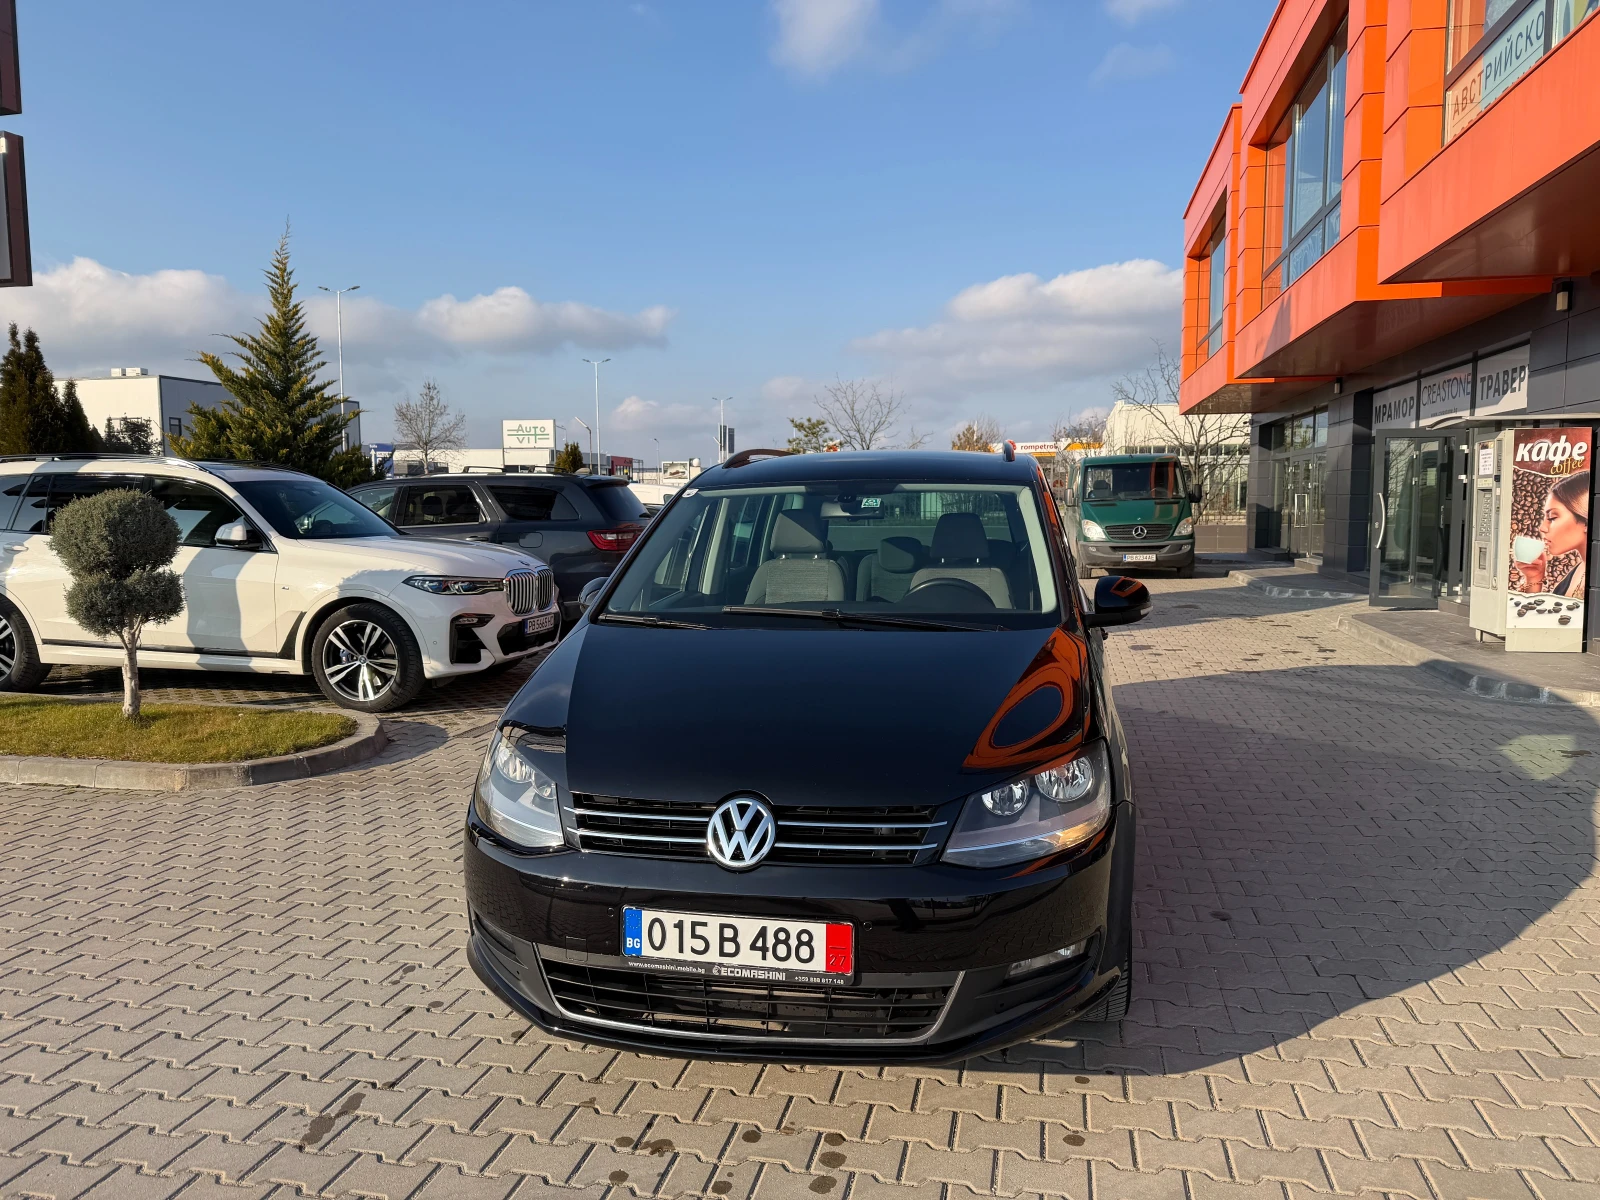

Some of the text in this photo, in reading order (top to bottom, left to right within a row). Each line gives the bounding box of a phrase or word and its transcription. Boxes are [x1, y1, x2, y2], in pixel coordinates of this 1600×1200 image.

[1452, 10, 1545, 120] АВСТРИЙСКО
[1421, 373, 1471, 407] CREASTONE
[1480, 364, 1530, 400] ТРАВЕР
[1374, 396, 1415, 424] МРАМОР
[1020, 443, 1058, 451] rompetrol
[1516, 435, 1588, 466] кафе
[1550, 457, 1584, 475] coffee
[626, 937, 641, 949] BG
